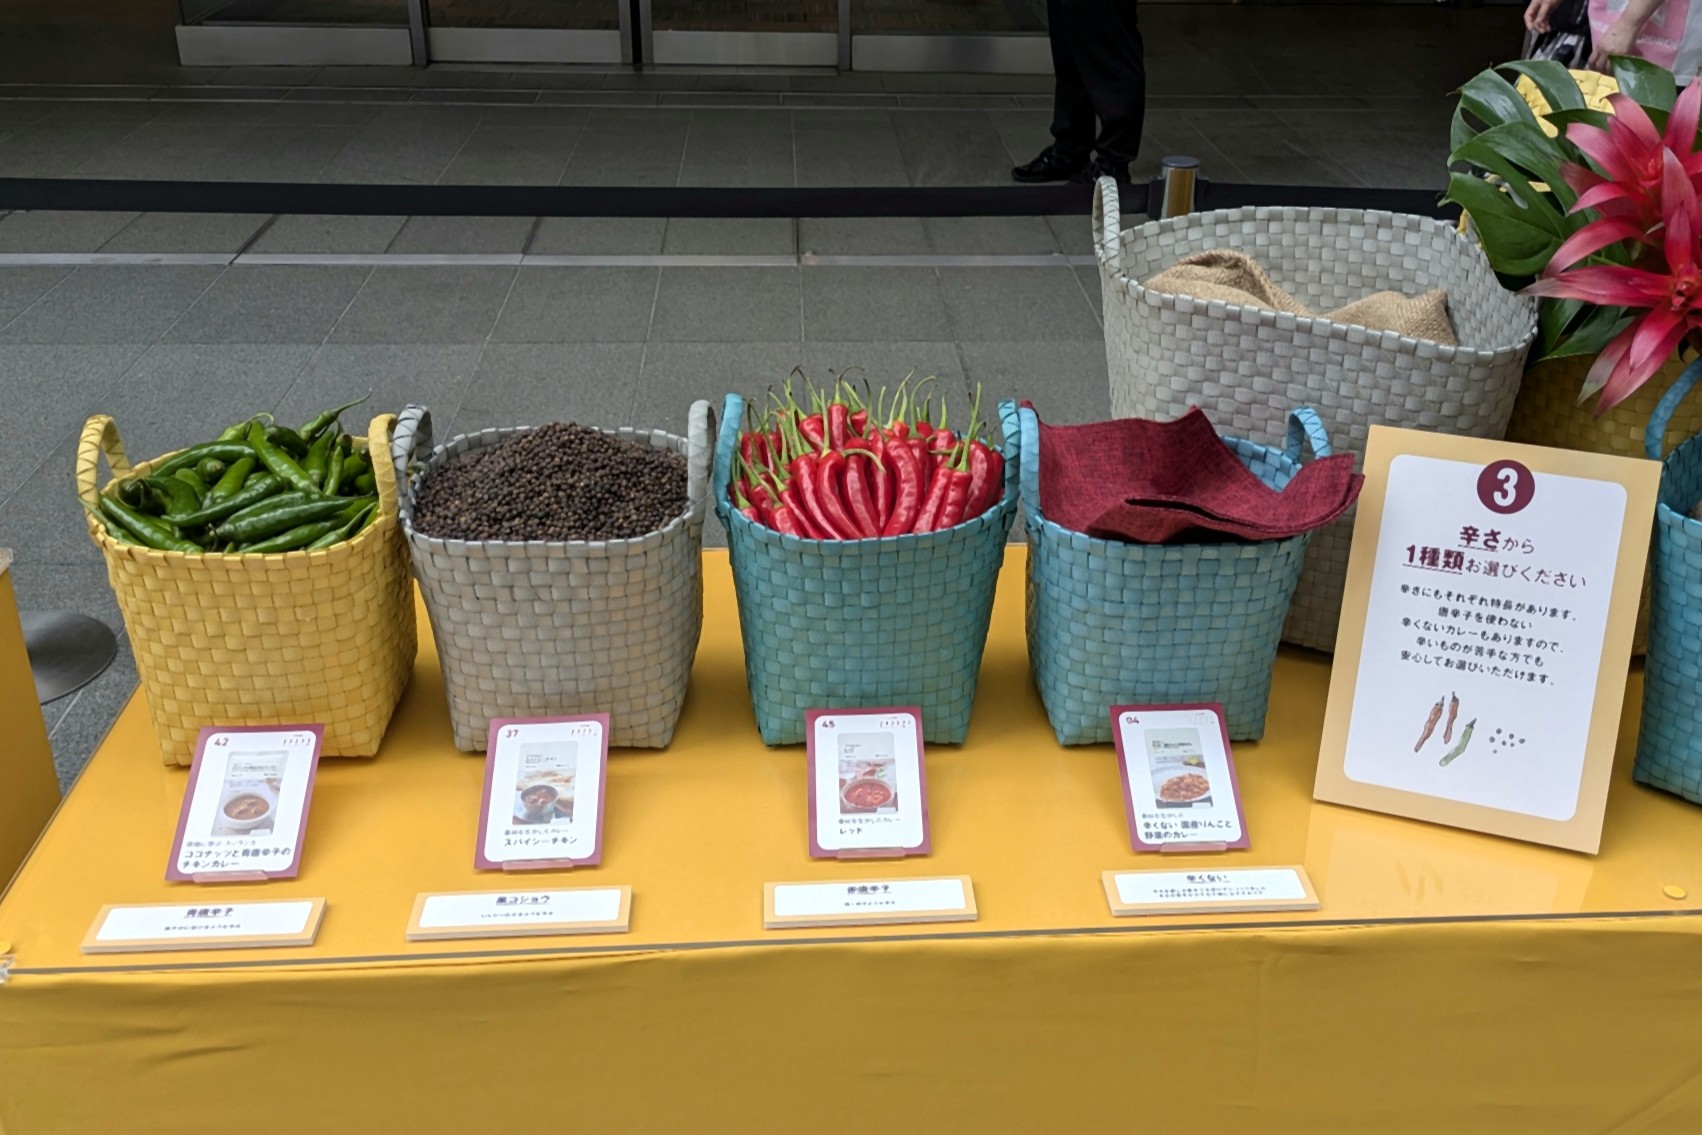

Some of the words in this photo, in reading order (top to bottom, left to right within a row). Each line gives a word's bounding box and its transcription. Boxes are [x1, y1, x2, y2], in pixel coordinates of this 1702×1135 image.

[1493, 467, 1519, 507] 3
[1459, 525, 1535, 554] 辛さから
[1404, 545, 1587, 588] 1種類お選びください
[1400, 583, 1577, 621] 辛さにもそれぞれ特長があります。
[1438, 607, 1533, 630] 唐辛子を使わない
[1416, 635, 1545, 667] 辛いものが苦手な方でも
[1400, 650, 1555, 686] 安心してお選びいただけます。
[214, 737, 229, 747] 42
[505, 729, 519, 738] 37
[504, 837, 578, 847] スパイシーチキン
[839, 827, 863, 835] レッド
[182, 860, 239, 869] チキンカレー
